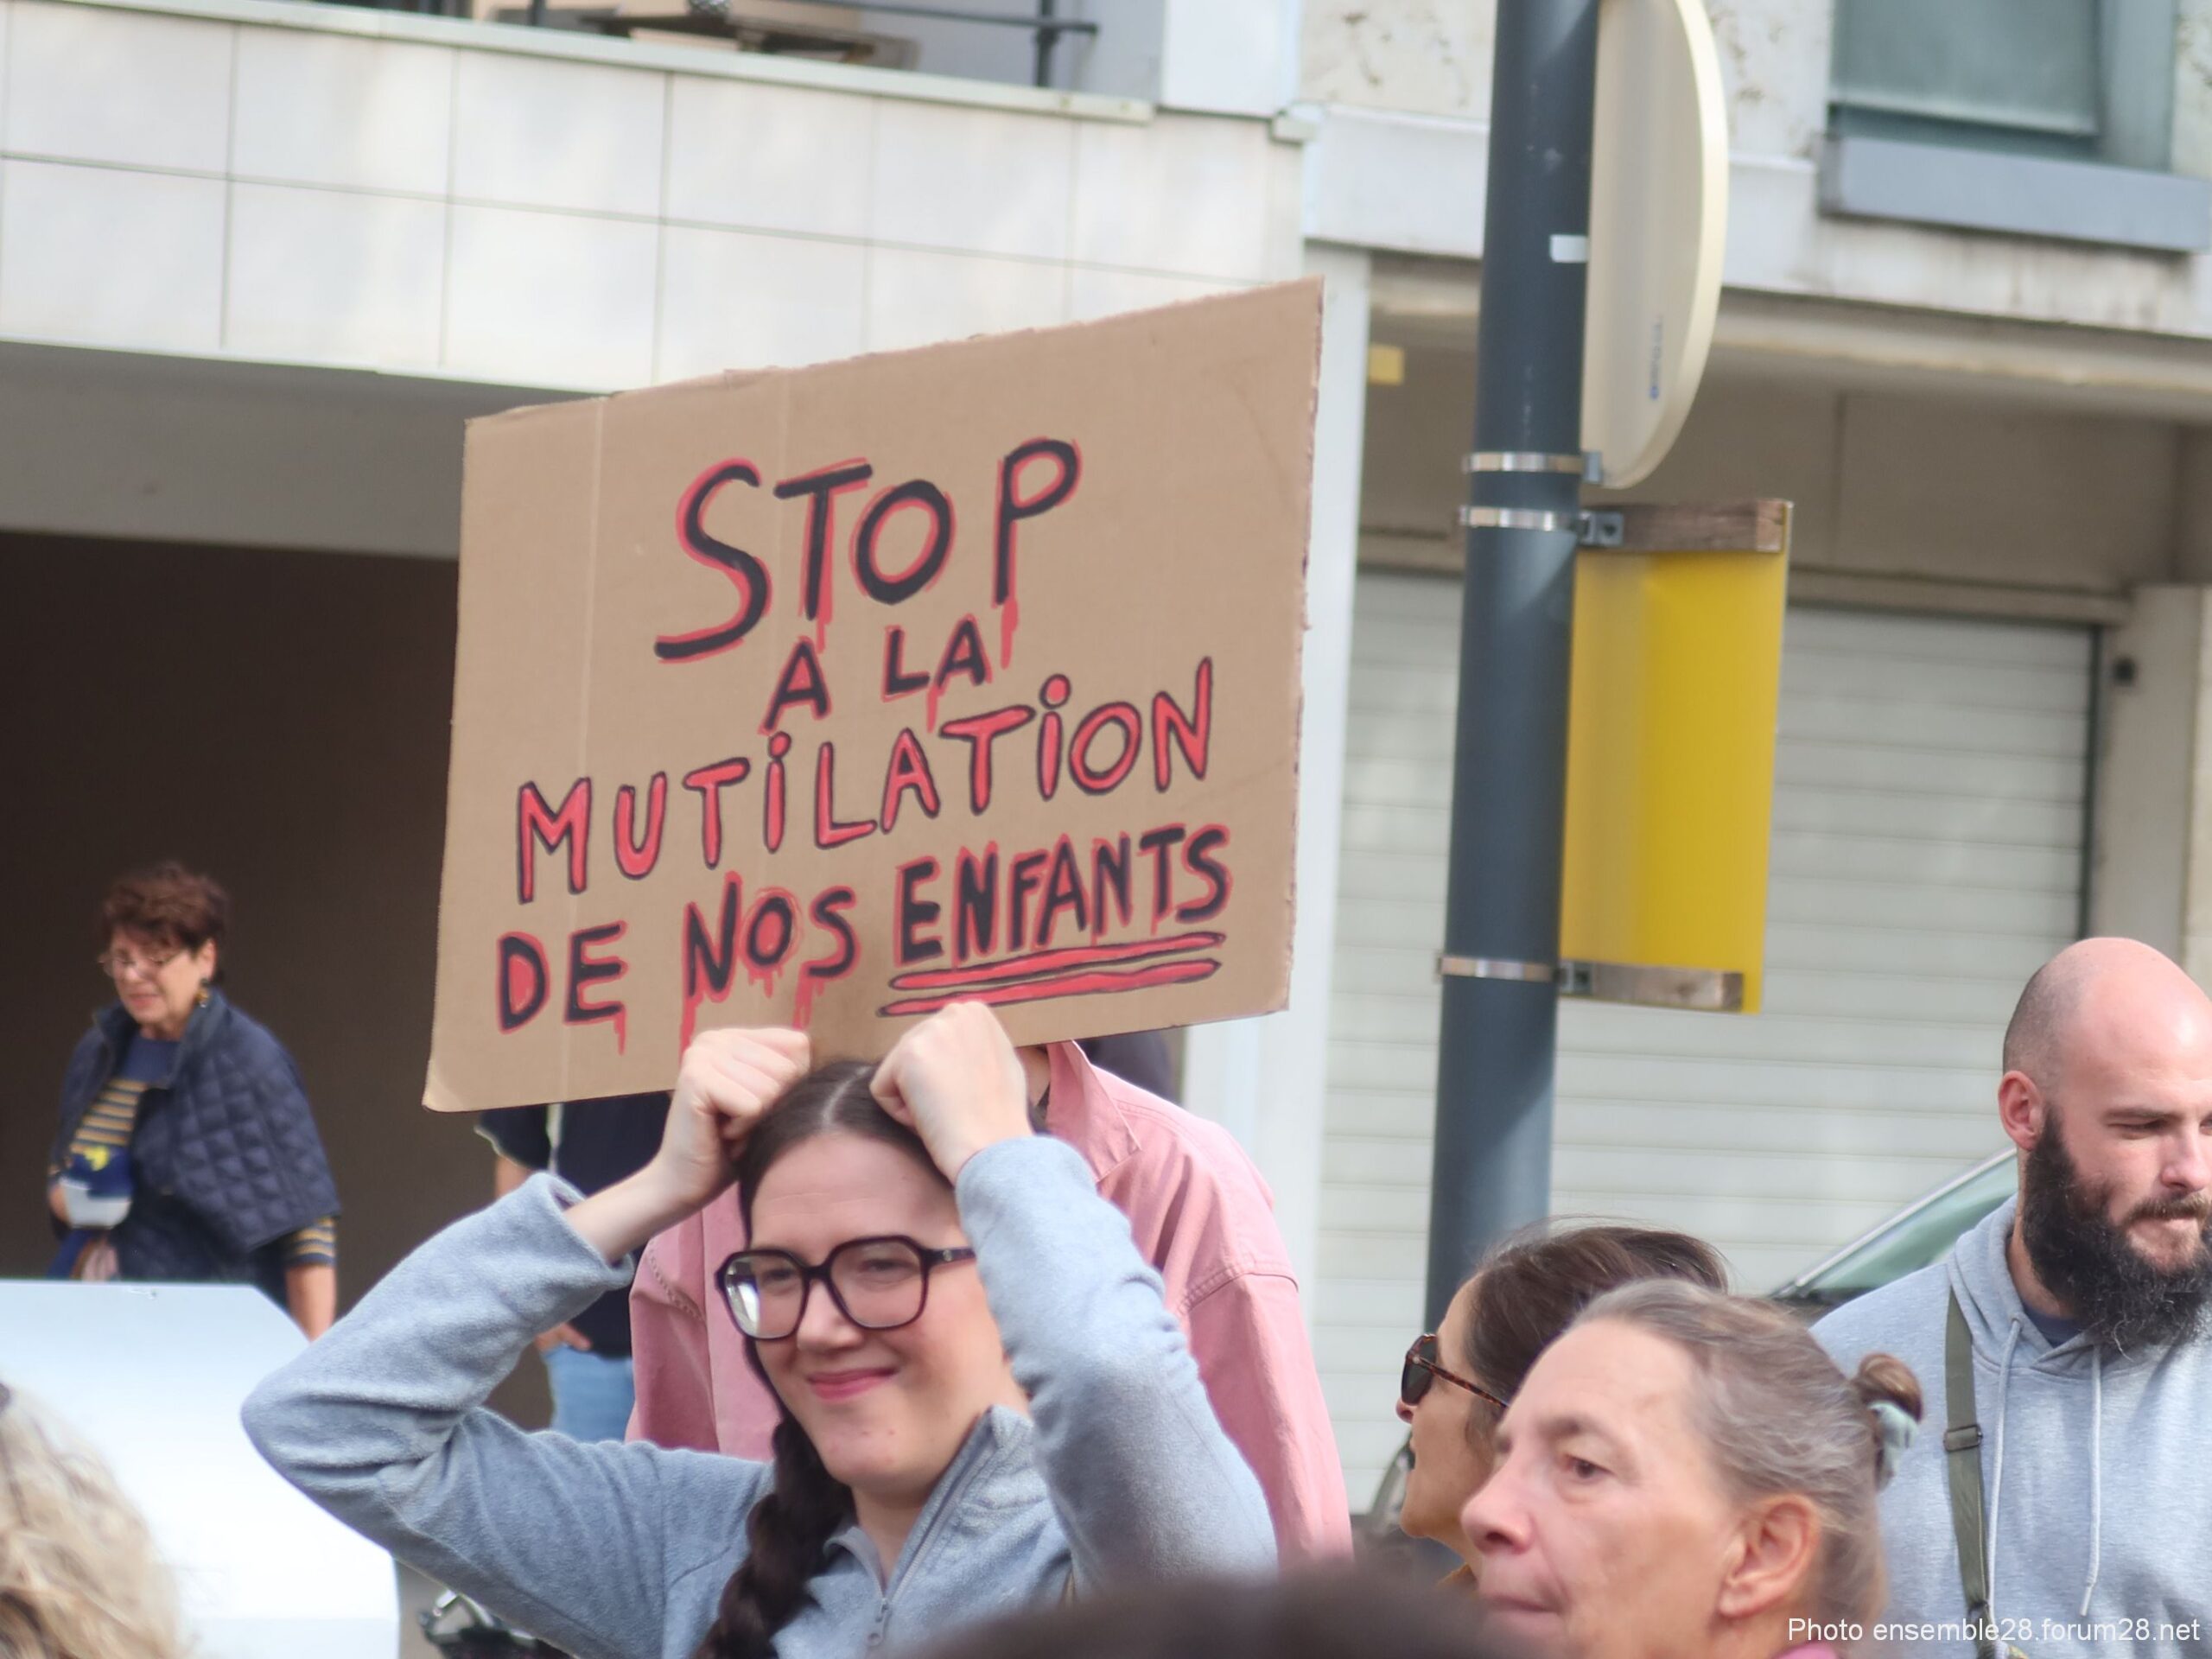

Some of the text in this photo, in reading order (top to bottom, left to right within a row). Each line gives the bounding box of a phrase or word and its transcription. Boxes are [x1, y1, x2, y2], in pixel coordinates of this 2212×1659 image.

[654, 438, 1082, 664] STOP
[759, 615, 991, 733] A LA
[496, 824, 1232, 1032] DE NOS ENFANTS
